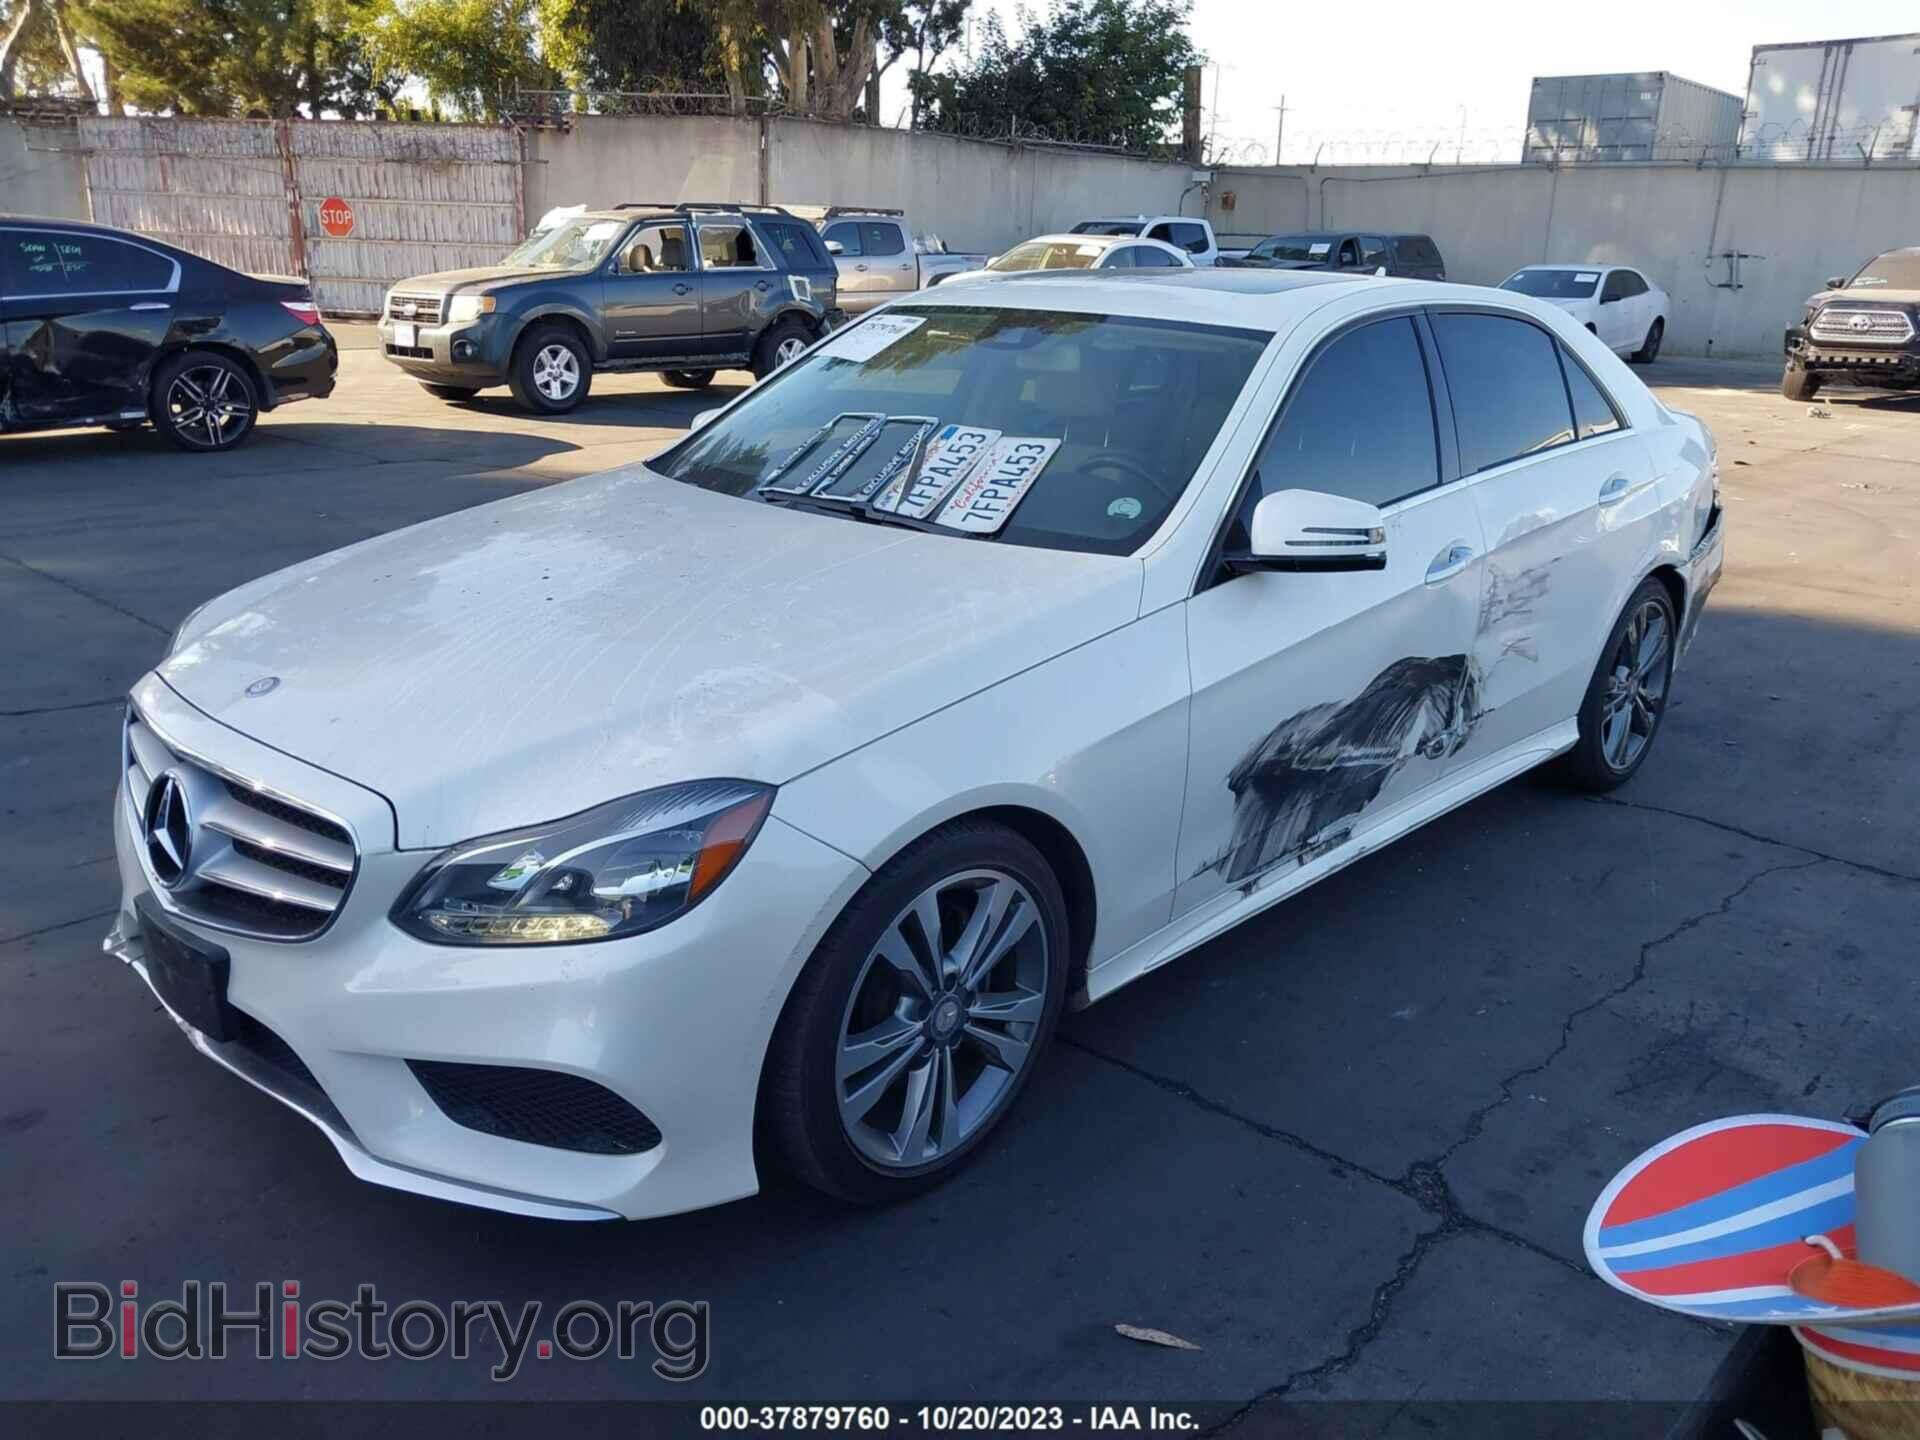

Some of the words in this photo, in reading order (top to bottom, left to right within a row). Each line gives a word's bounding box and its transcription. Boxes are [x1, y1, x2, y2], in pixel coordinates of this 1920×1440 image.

[321, 208, 351, 225] STOP
[903, 432, 987, 508] 7FPA453
[961, 443, 1046, 523] 7FPA453
